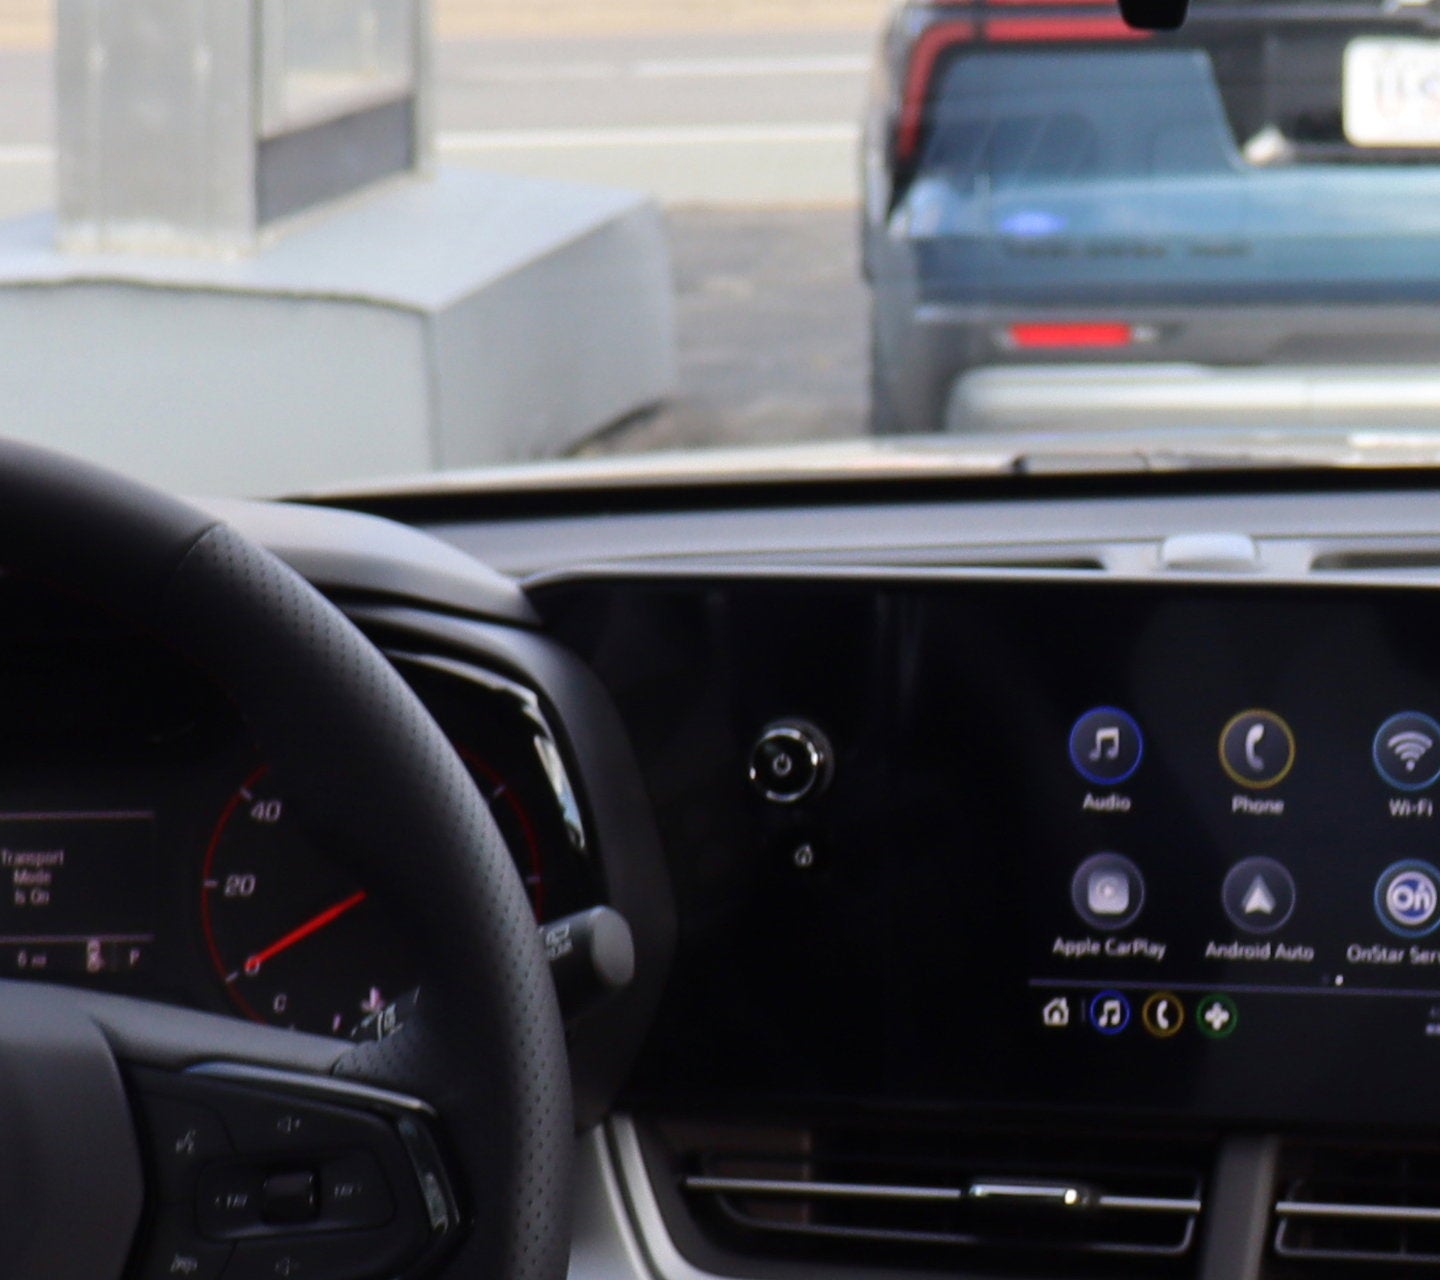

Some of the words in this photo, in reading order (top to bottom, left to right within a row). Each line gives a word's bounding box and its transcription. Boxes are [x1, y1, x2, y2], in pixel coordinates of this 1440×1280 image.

[250, 801, 282, 824] 40
[1082, 792, 1131, 813] Audio
[1231, 794, 1285, 815] Phone
[1388, 797, 1433, 818] Wi-Fi
[0, 847, 66, 867] Transport
[224, 874, 256, 897] 20
[1052, 936, 1101, 958] Apple
[1104, 938, 1167, 961] CarPlay
[1204, 940, 1272, 961] Android
[1273, 942, 1315, 962] Auto
[1346, 943, 1406, 964] OnStar
